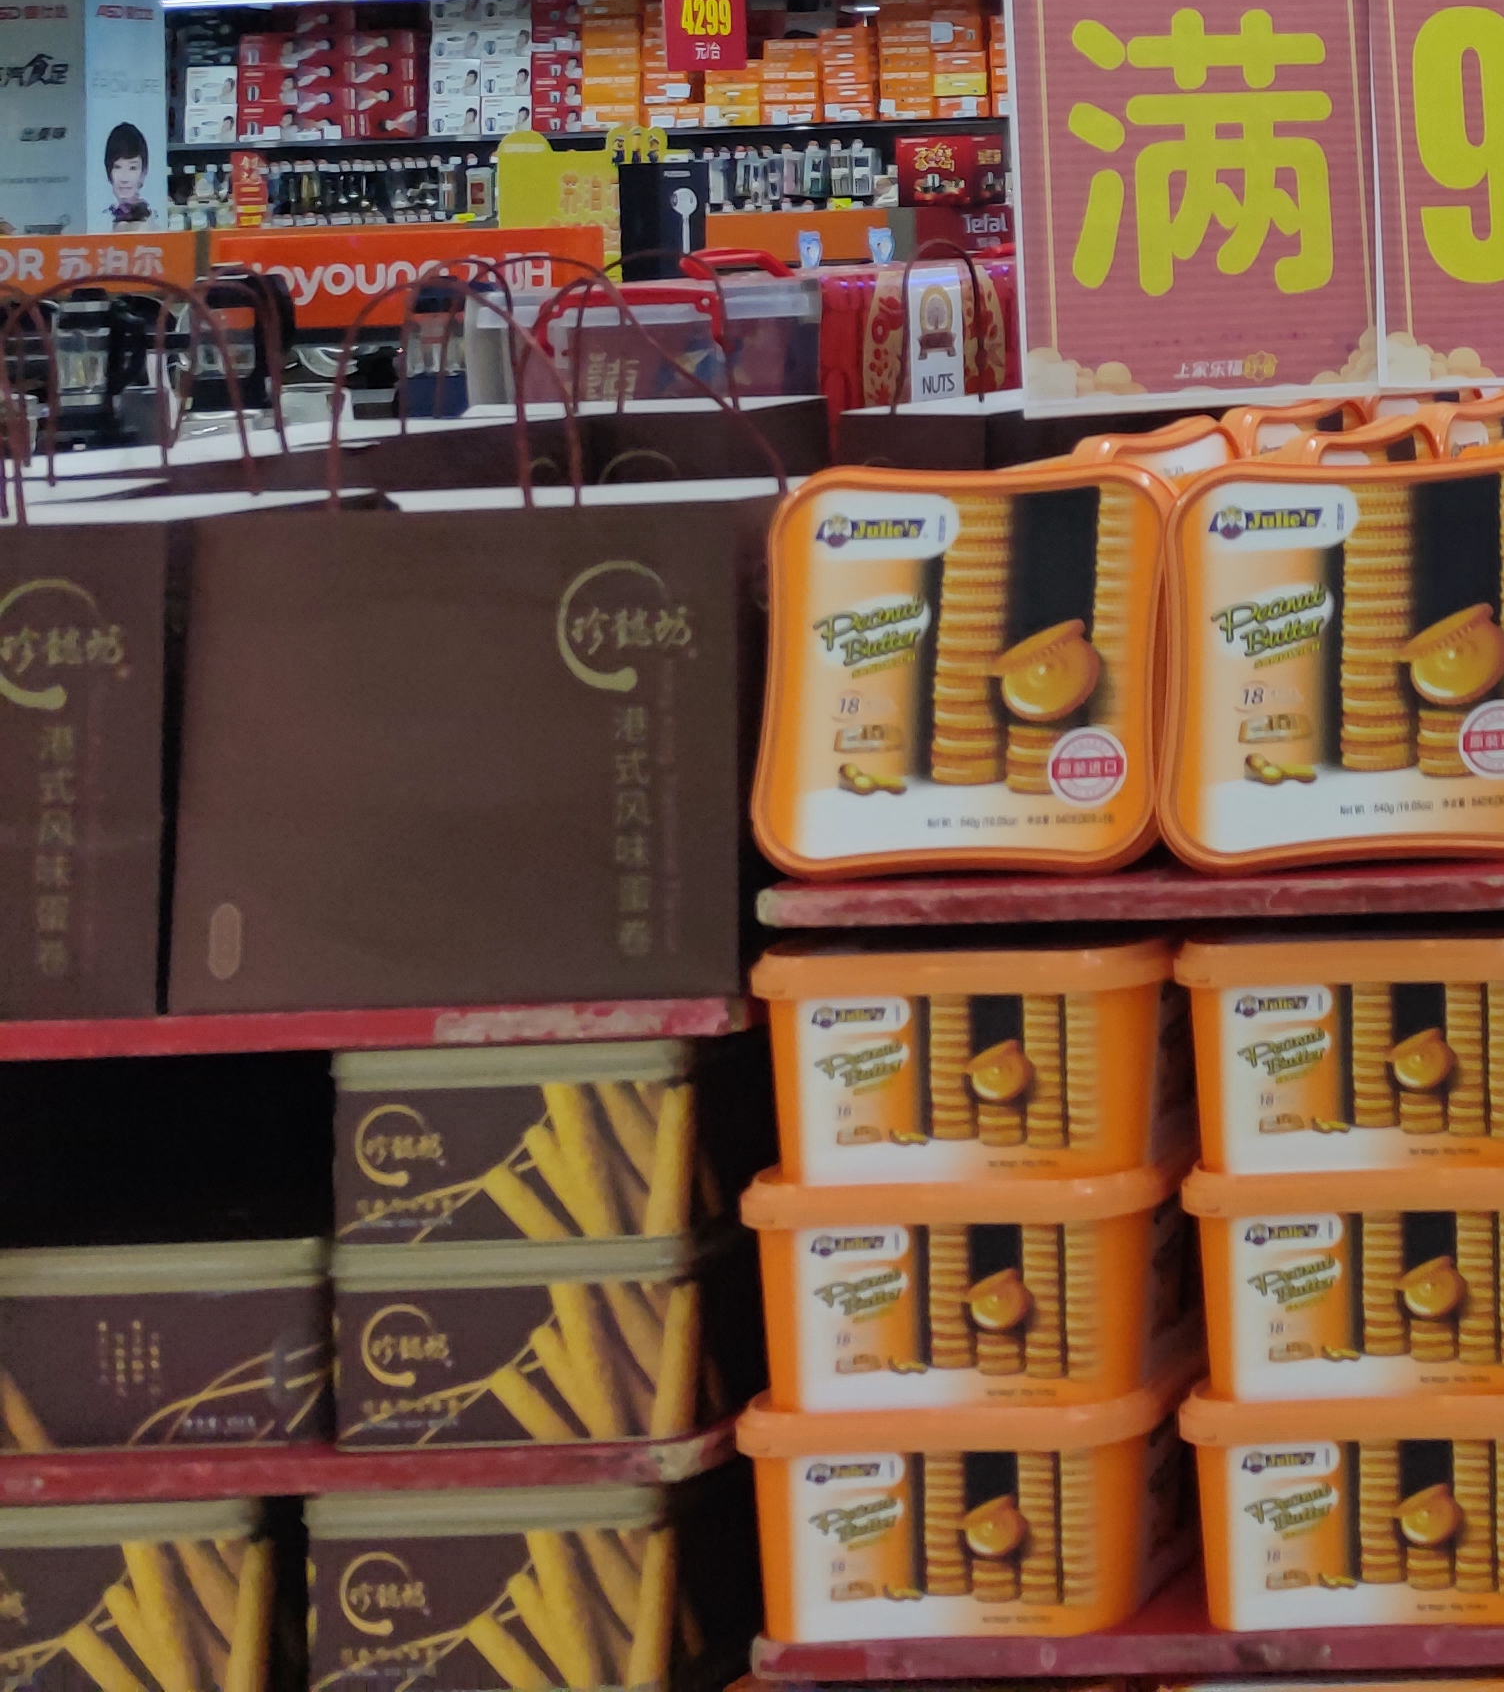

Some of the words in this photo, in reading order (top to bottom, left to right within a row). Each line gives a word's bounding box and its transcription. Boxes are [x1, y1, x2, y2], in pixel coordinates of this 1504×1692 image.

[1071, 8, 1332, 298] 满
[965, 213, 1009, 233] Tefal
[58, 246, 163, 278] 苏泊尔
[921, 374, 957, 395] NUTS
[853, 519, 921, 539] Julie's
[1248, 510, 1317, 529] Julie's
[813, 594, 925, 651] Peanut
[1211, 582, 1326, 643] Peanut
[841, 627, 921, 666] Butter
[1241, 615, 1325, 658] Butter
